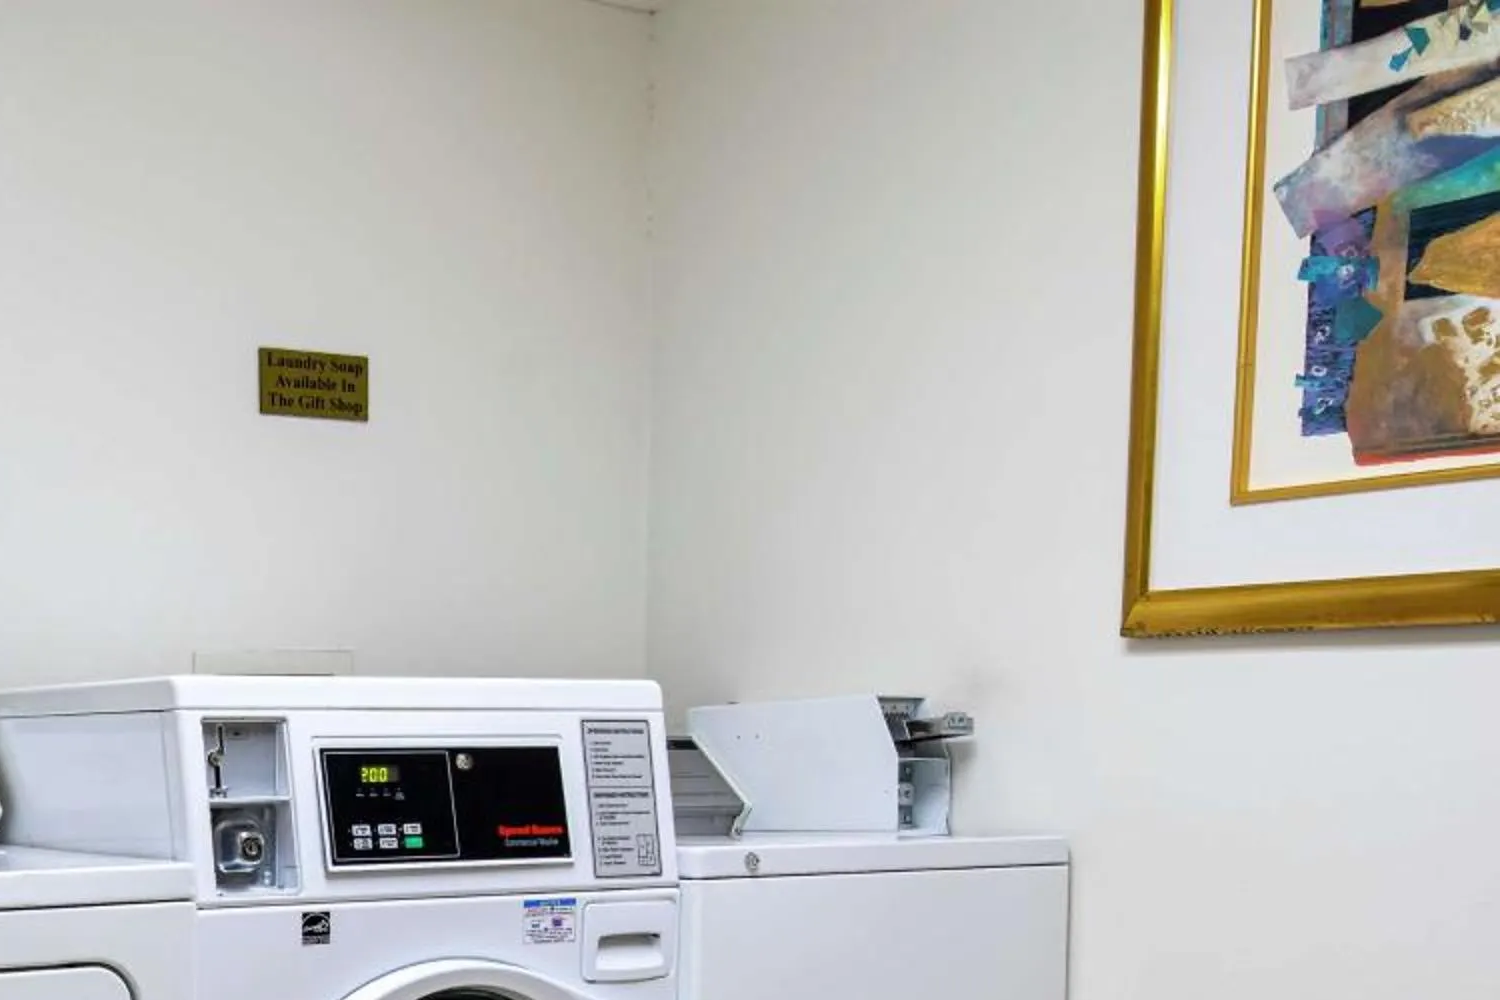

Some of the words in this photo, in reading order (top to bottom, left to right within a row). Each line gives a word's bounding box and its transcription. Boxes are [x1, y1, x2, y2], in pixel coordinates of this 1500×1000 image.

[267, 352, 325, 375] Laundry
[330, 361, 363, 378] Soap
[275, 375, 337, 391] Available
[341, 378, 356, 392] In
[268, 391, 294, 407] The
[298, 395, 325, 410] Gift
[330, 397, 363, 416] Shop
